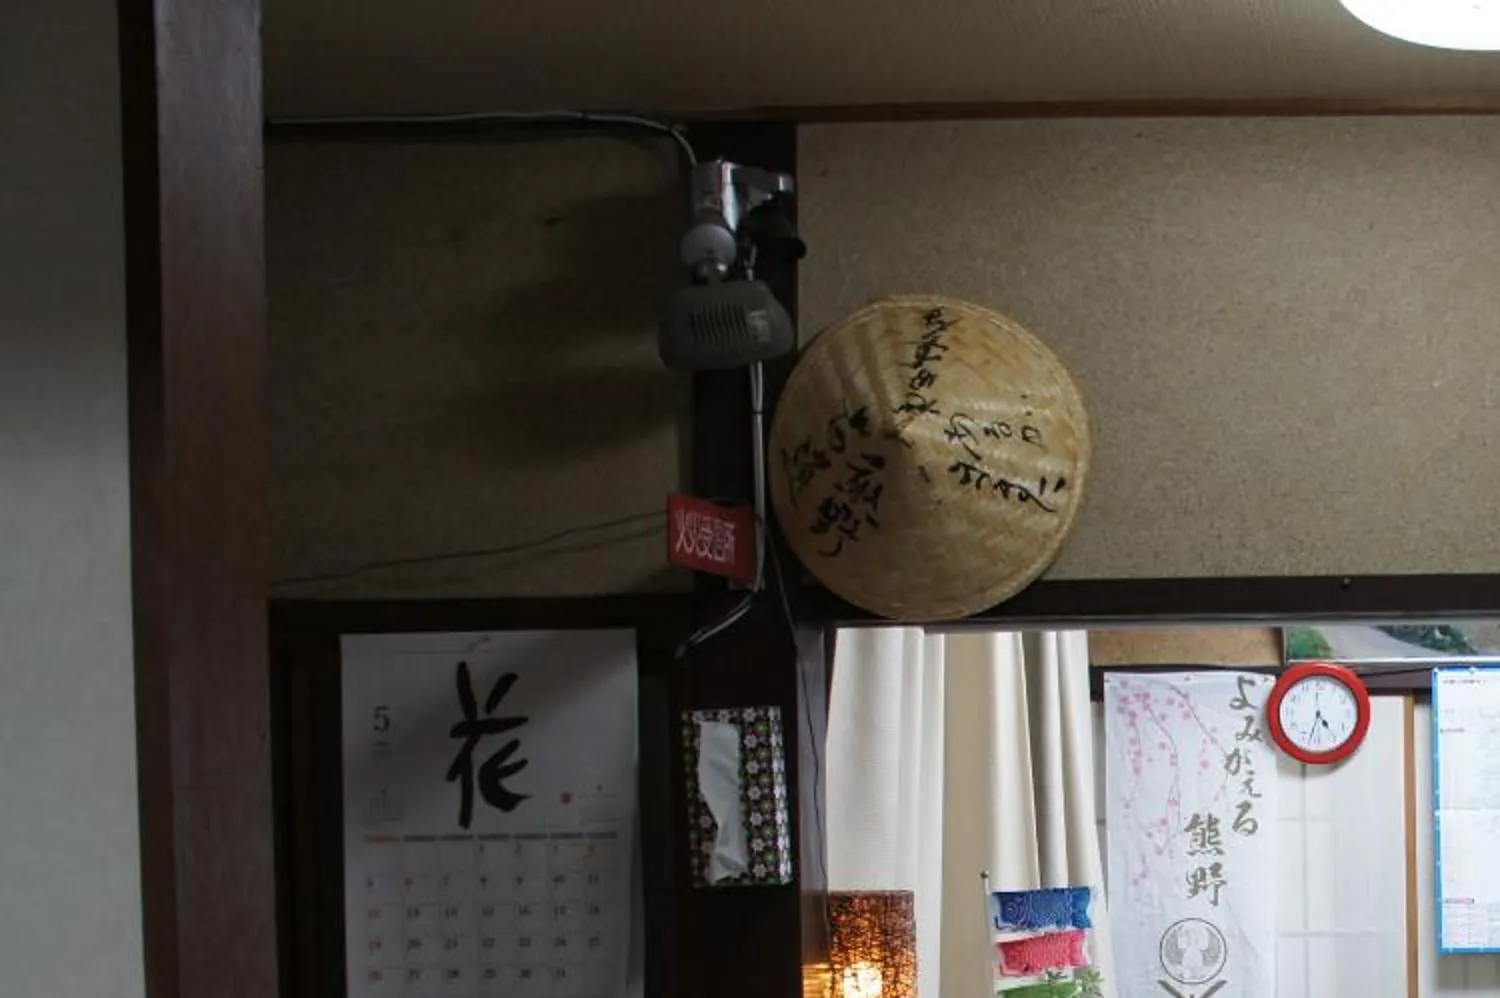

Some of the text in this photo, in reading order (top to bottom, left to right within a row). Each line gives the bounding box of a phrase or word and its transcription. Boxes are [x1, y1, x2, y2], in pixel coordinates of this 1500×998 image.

[373, 705, 391, 733] 5
[1223, 675, 1263, 837] よみがえる
[1184, 812, 1227, 907] 熊野
